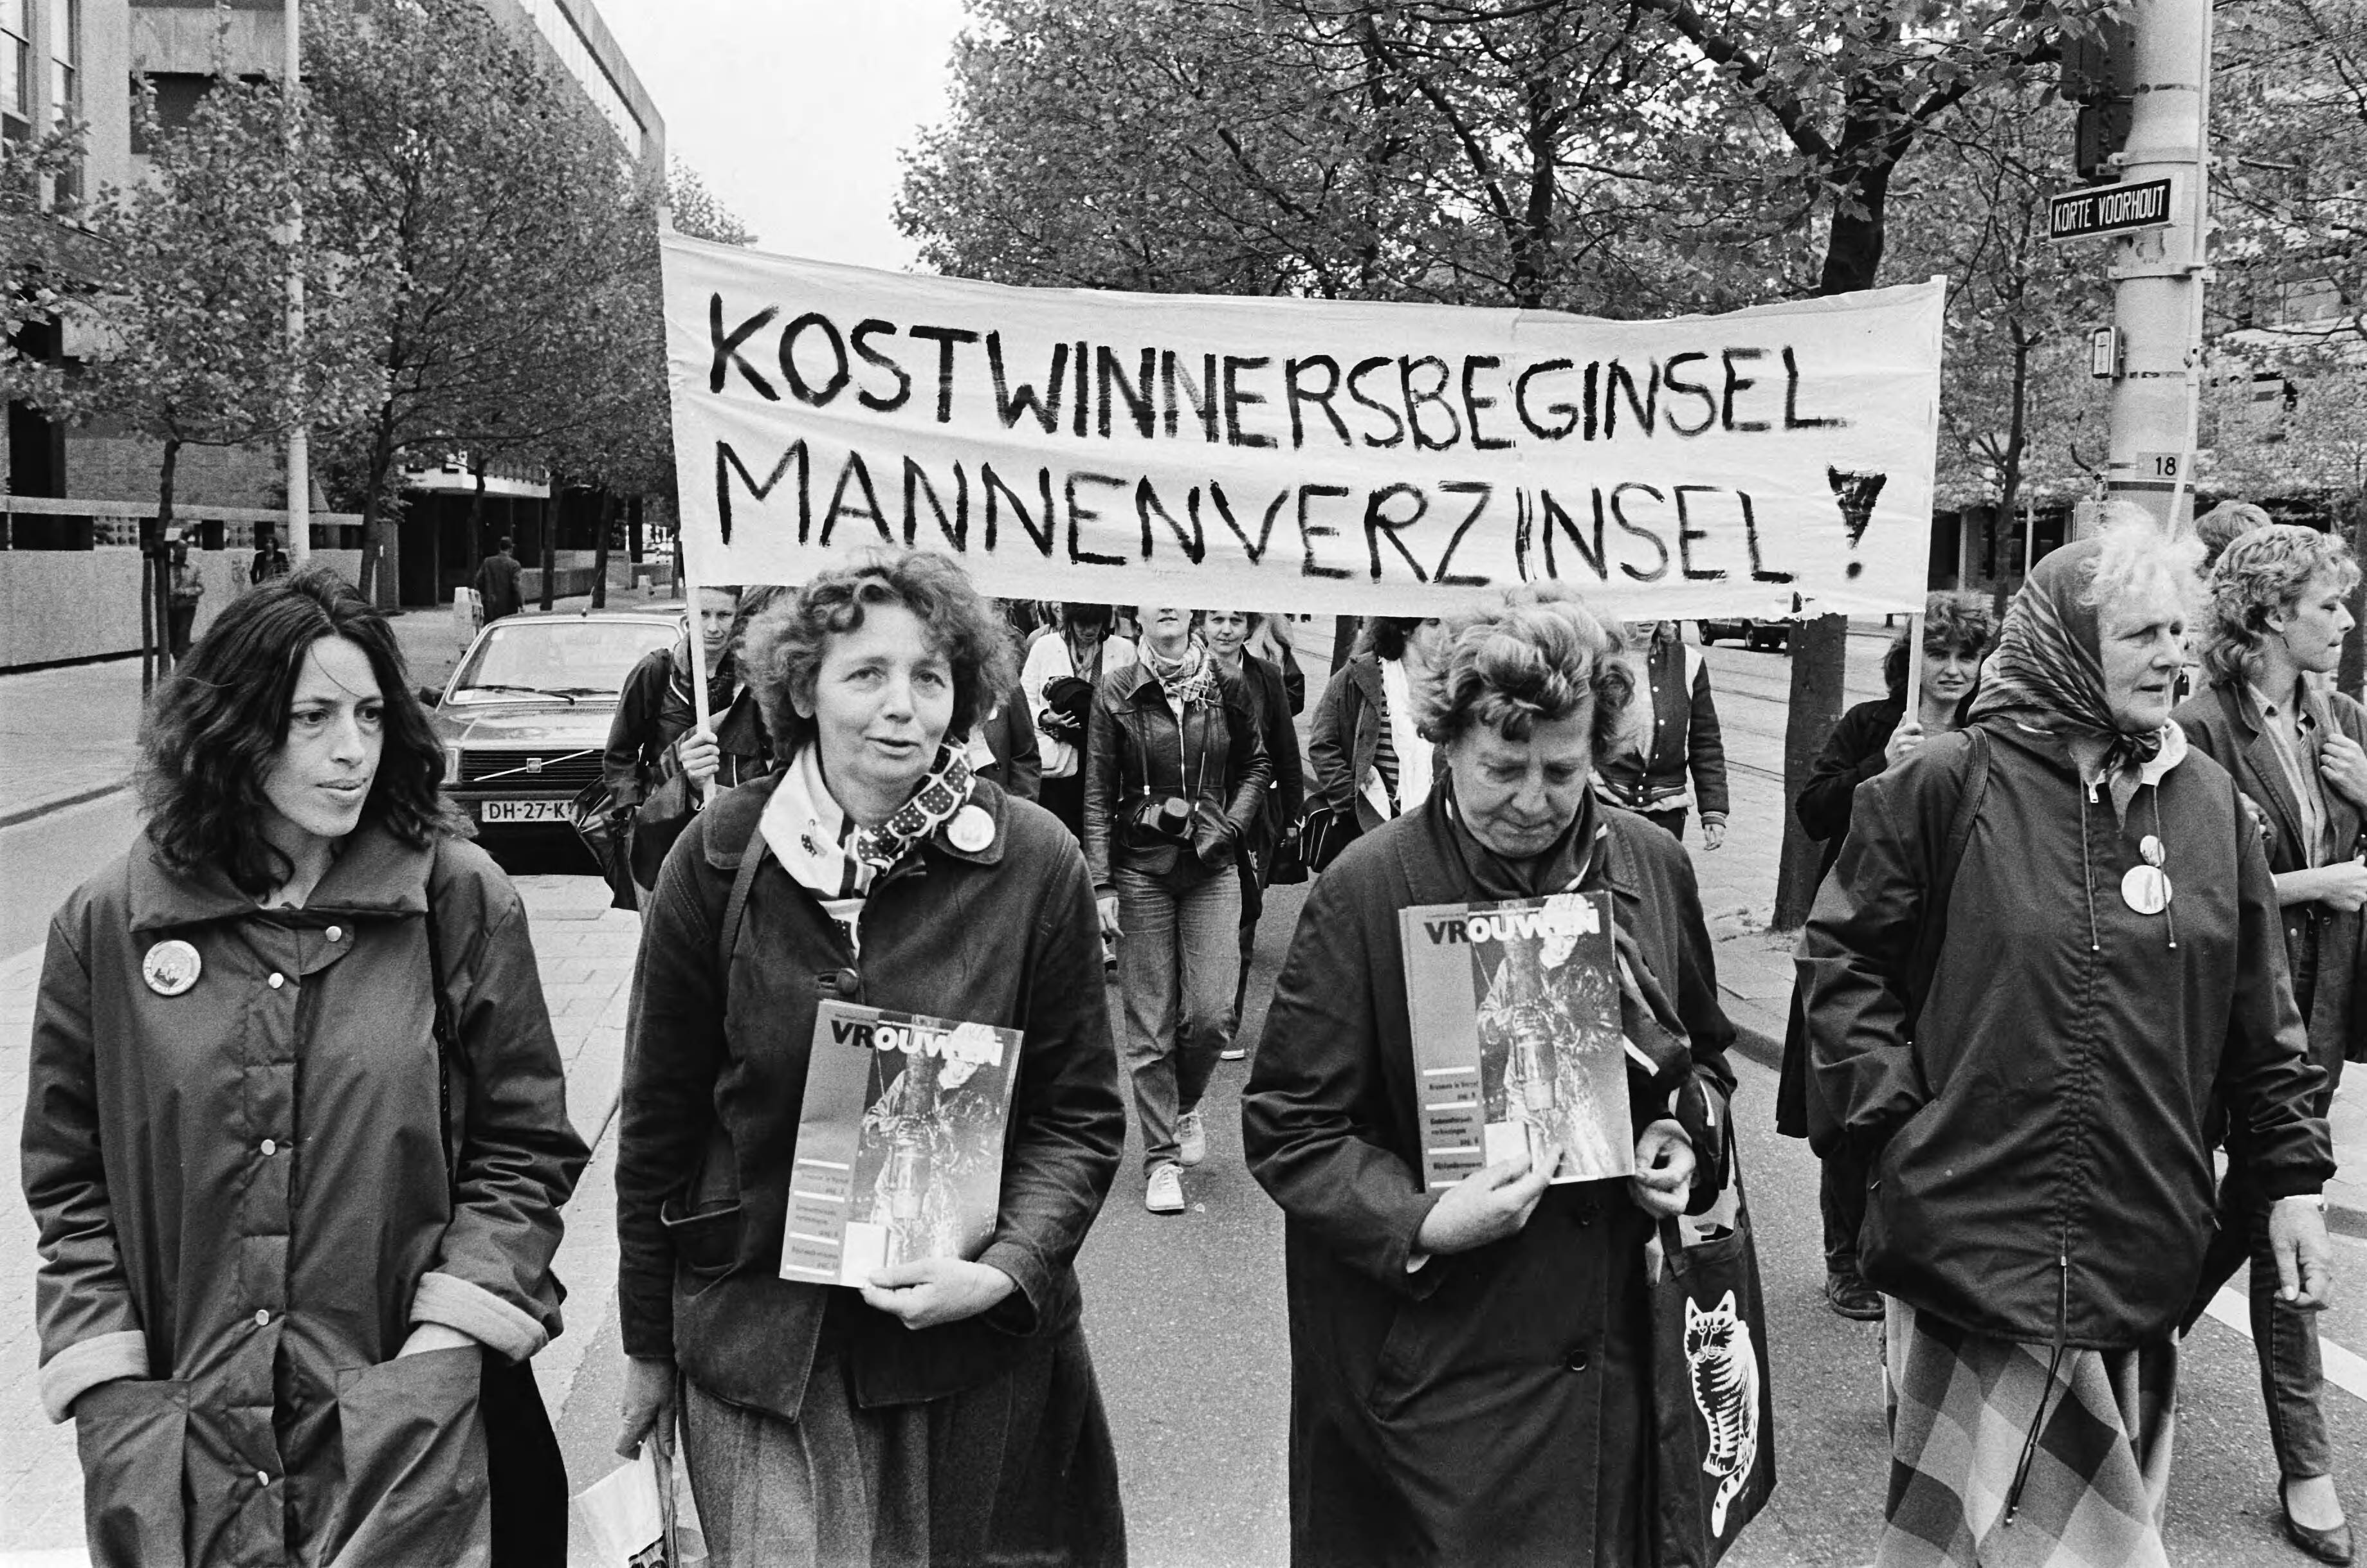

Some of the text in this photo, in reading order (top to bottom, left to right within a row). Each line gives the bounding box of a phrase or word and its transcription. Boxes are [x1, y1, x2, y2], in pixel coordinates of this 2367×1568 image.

[2054, 185, 2166, 232] KORTE VOORHOUT
[709, 291, 1852, 451] KOSTWINNERSBEGINSEL
[2155, 456, 2177, 476] 18
